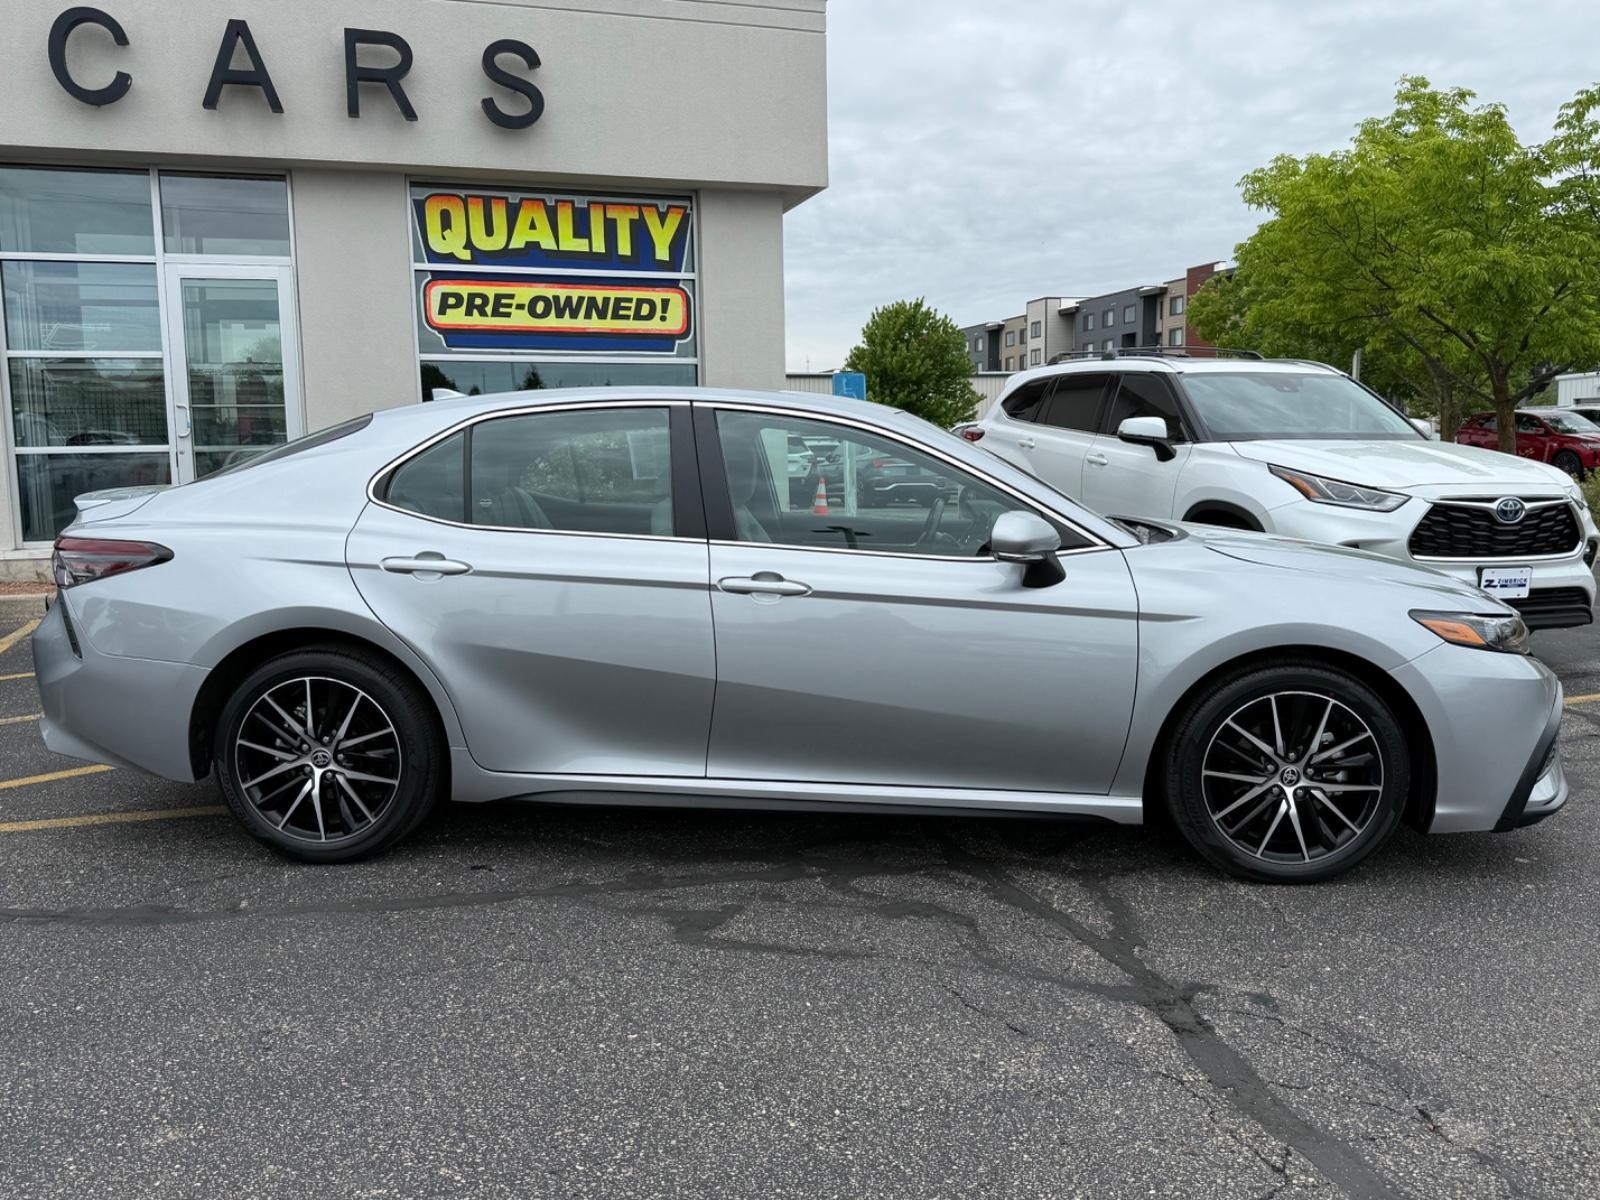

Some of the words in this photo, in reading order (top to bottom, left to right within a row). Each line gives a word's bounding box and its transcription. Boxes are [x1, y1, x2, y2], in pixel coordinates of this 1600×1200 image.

[47, 6, 546, 130] CARS
[424, 194, 685, 262] QUALITY
[437, 291, 671, 322] PRE-OWNED!
